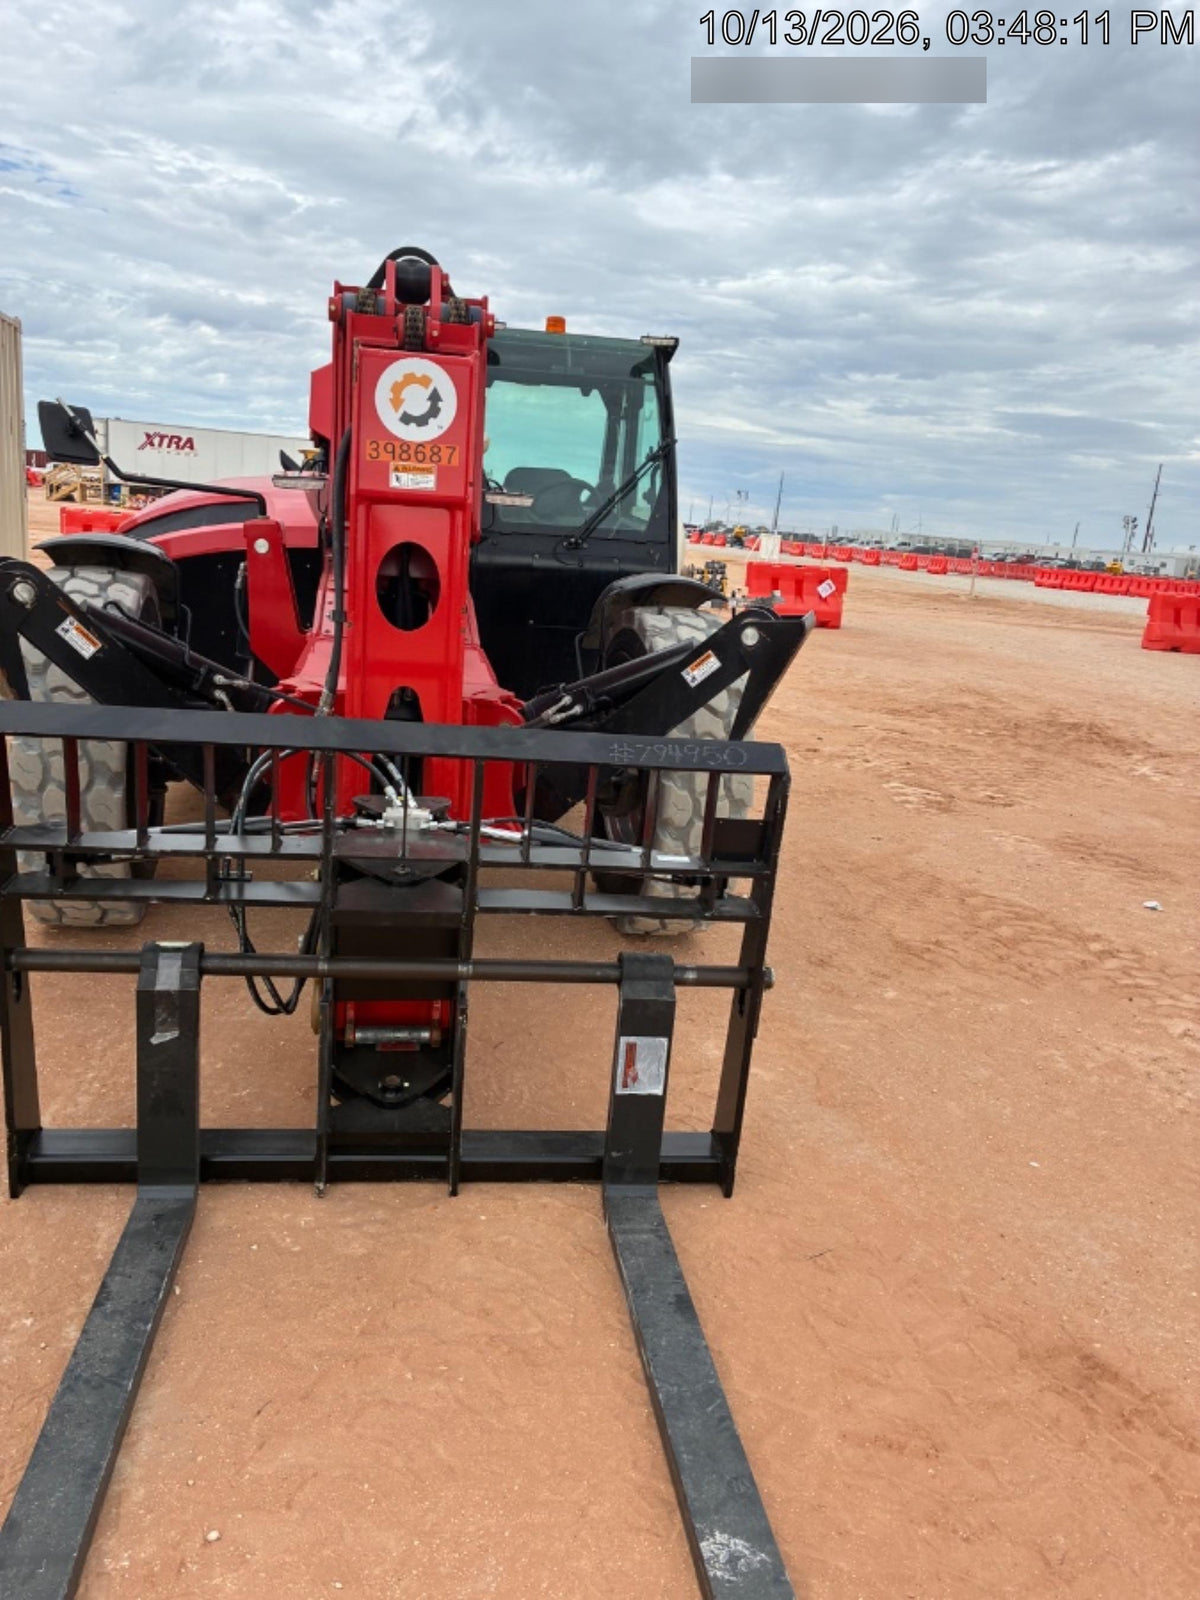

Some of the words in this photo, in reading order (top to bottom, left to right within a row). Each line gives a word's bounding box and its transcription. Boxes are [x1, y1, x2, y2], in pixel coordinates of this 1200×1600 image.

[137, 431, 195, 451] XTRA
[368, 440, 457, 465] 398687
[609, 741, 748, 767] #794950
